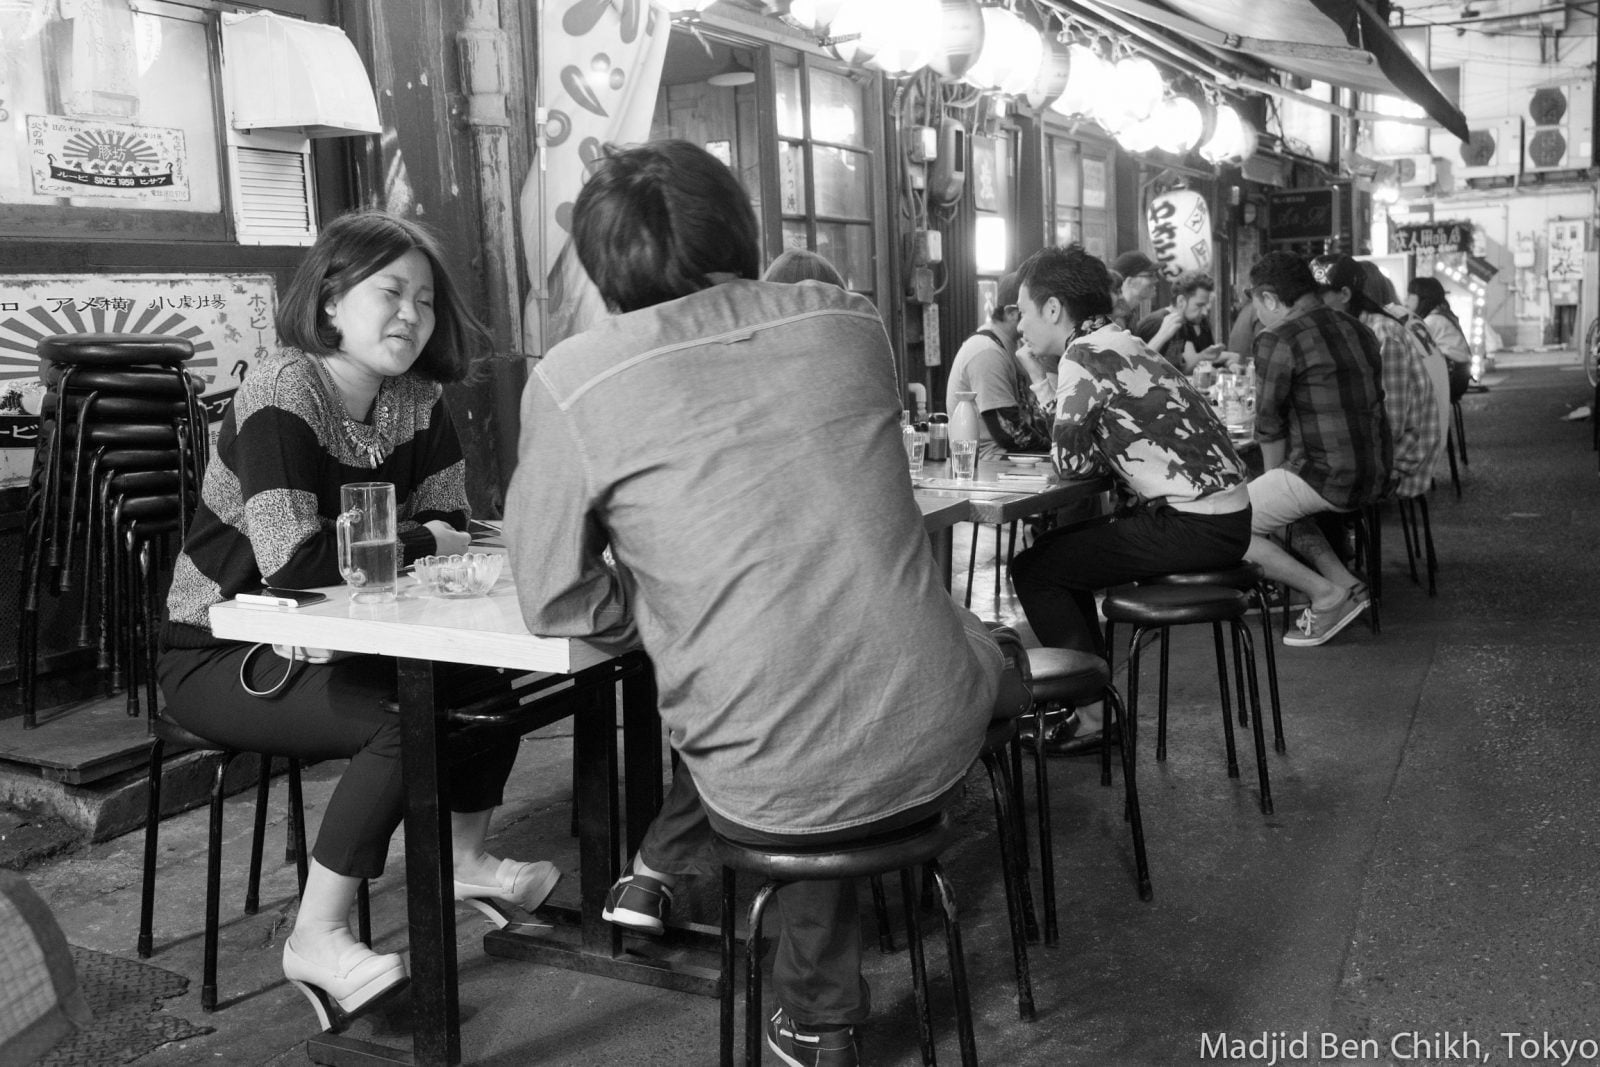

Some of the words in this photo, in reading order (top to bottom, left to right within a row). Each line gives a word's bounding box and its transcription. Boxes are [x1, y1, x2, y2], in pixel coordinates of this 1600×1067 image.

[94, 176, 117, 186] SINCE
[46, 296, 128, 313] アメ横
[149, 294, 227, 310] 小劇場
[247, 293, 269, 364] ホッピーあ
